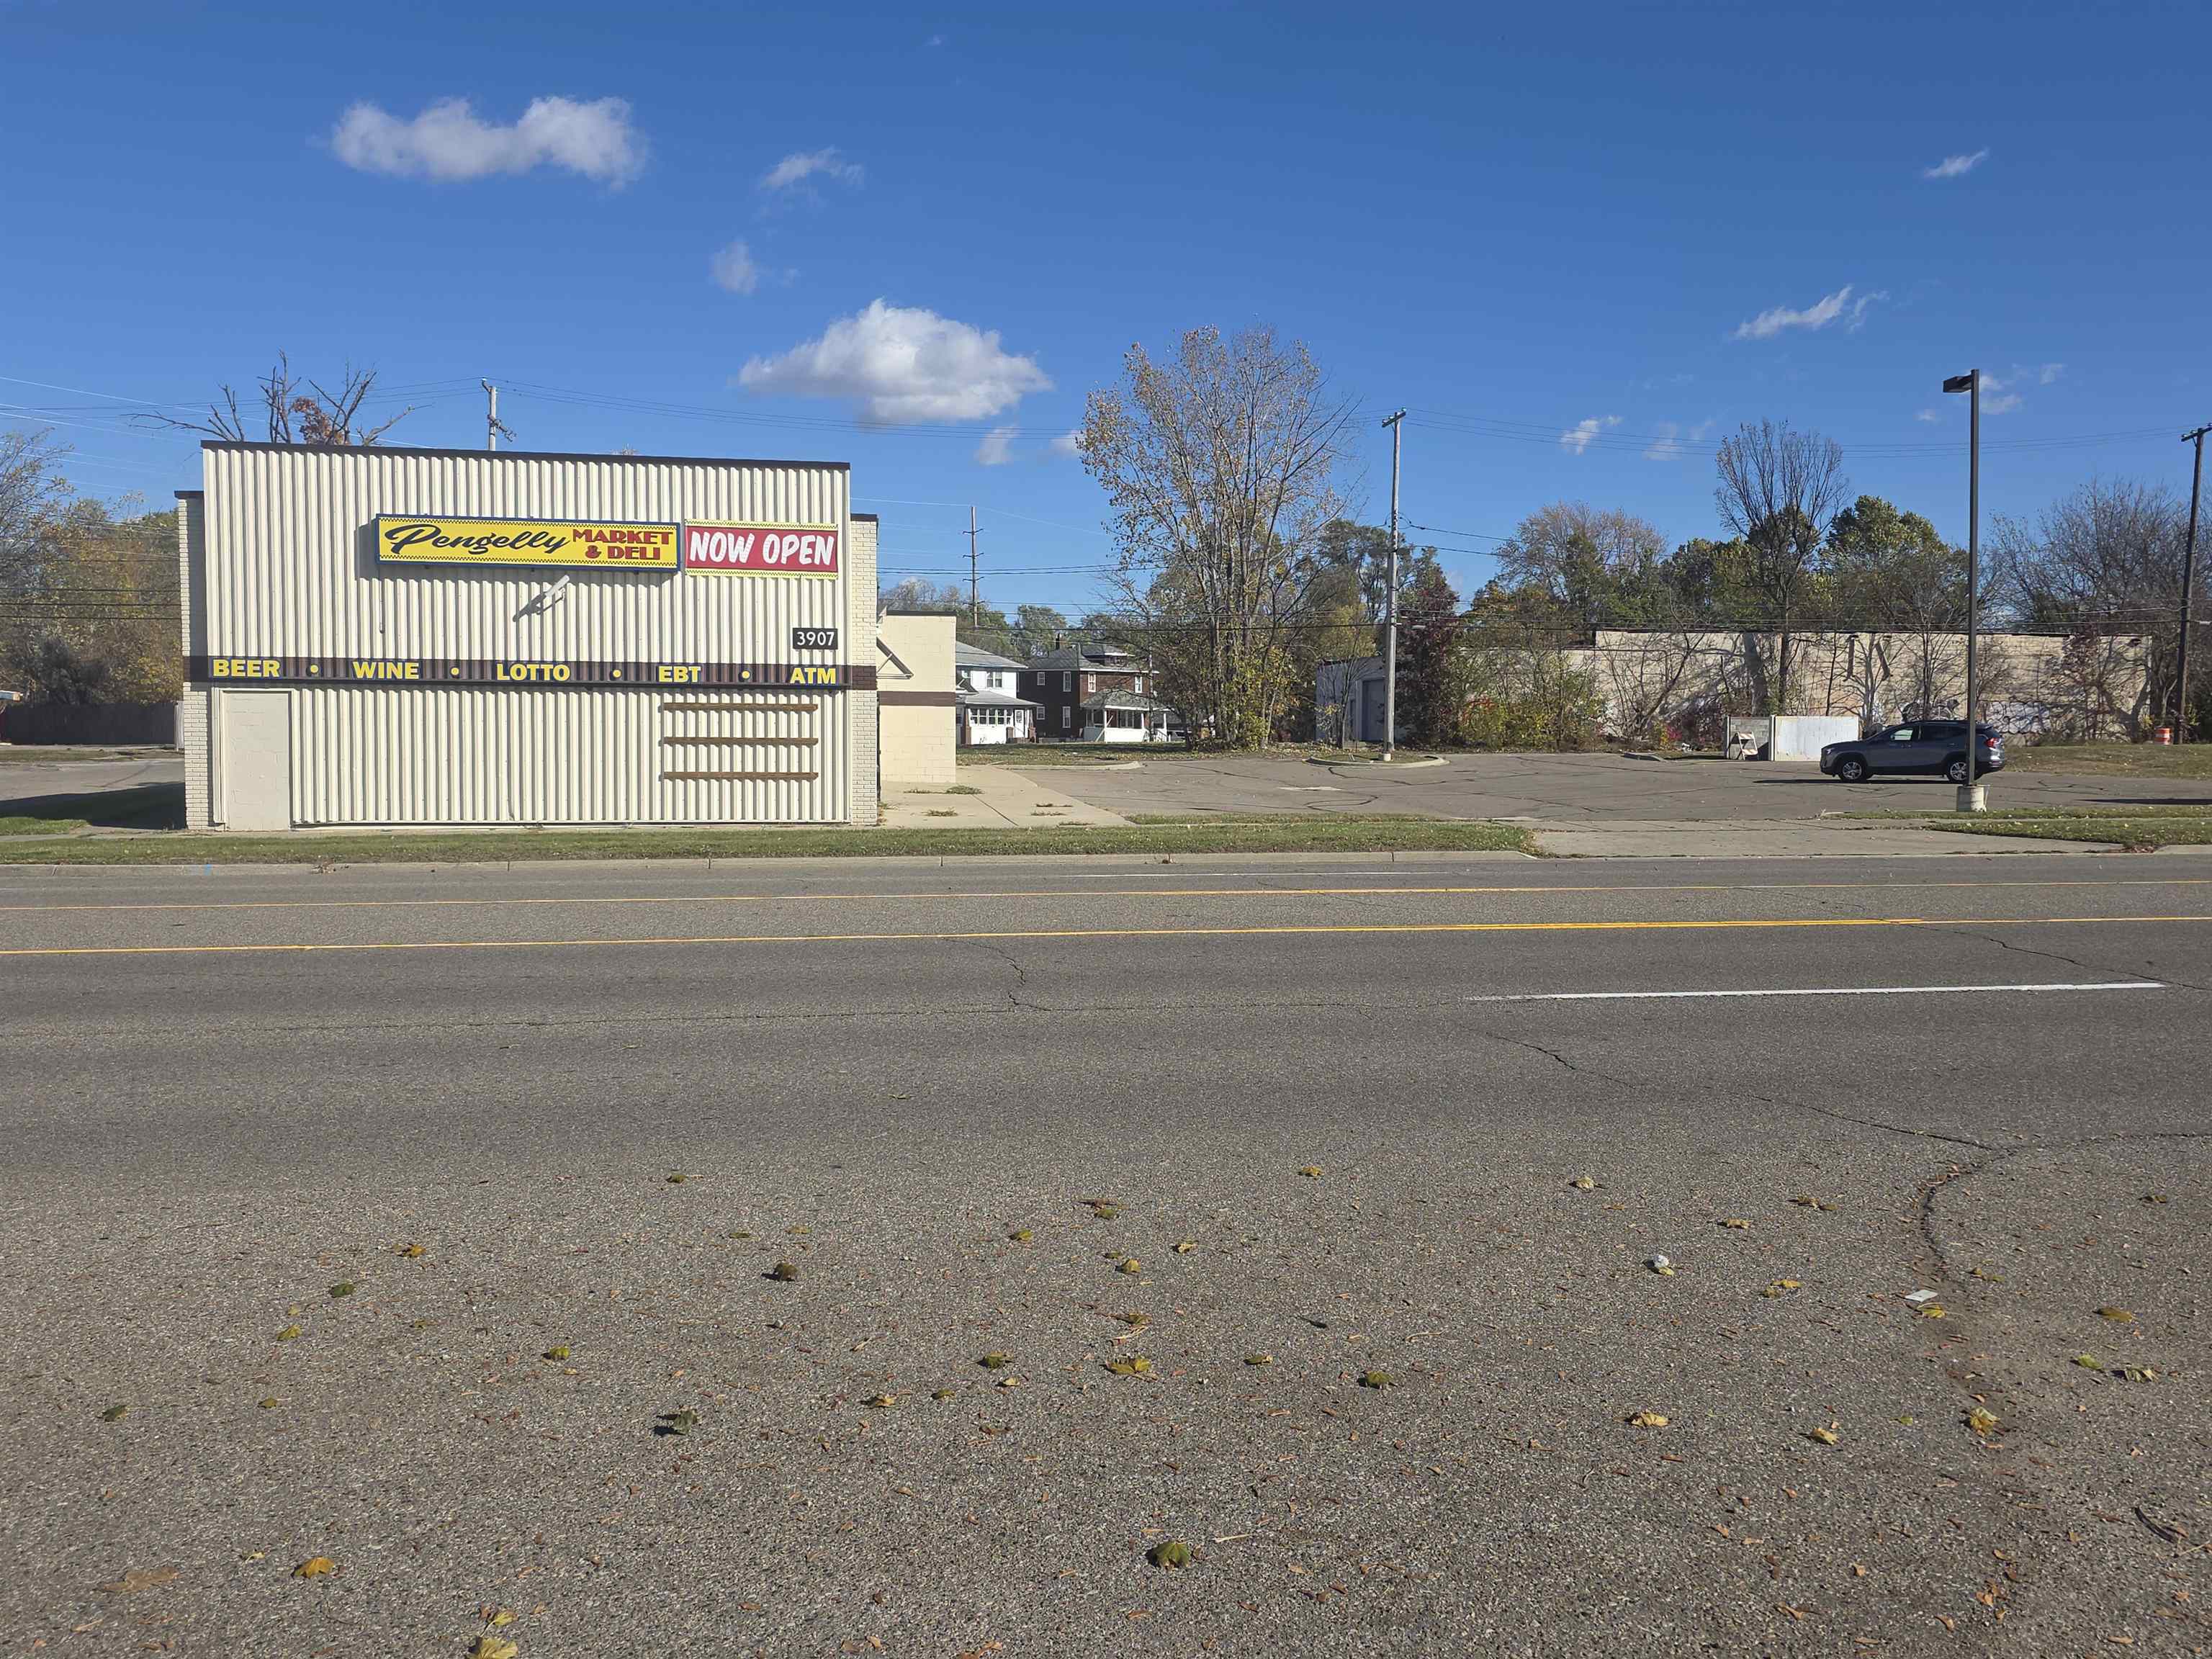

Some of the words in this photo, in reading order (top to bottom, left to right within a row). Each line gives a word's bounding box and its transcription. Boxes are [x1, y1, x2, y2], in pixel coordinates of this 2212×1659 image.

[384, 523, 570, 554] Pengelly
[572, 529, 674, 545] MARKET
[585, 544, 602, 559] &
[607, 545, 661, 560] DELI
[689, 531, 755, 563] NOW
[762, 533, 835, 566] OPEN
[796, 631, 835, 646] 3907
[212, 658, 281, 678] BEER
[352, 660, 420, 679] WINE
[496, 662, 571, 681] LOTTO
[658, 665, 702, 683] EBT
[790, 667, 837, 685] ATM
